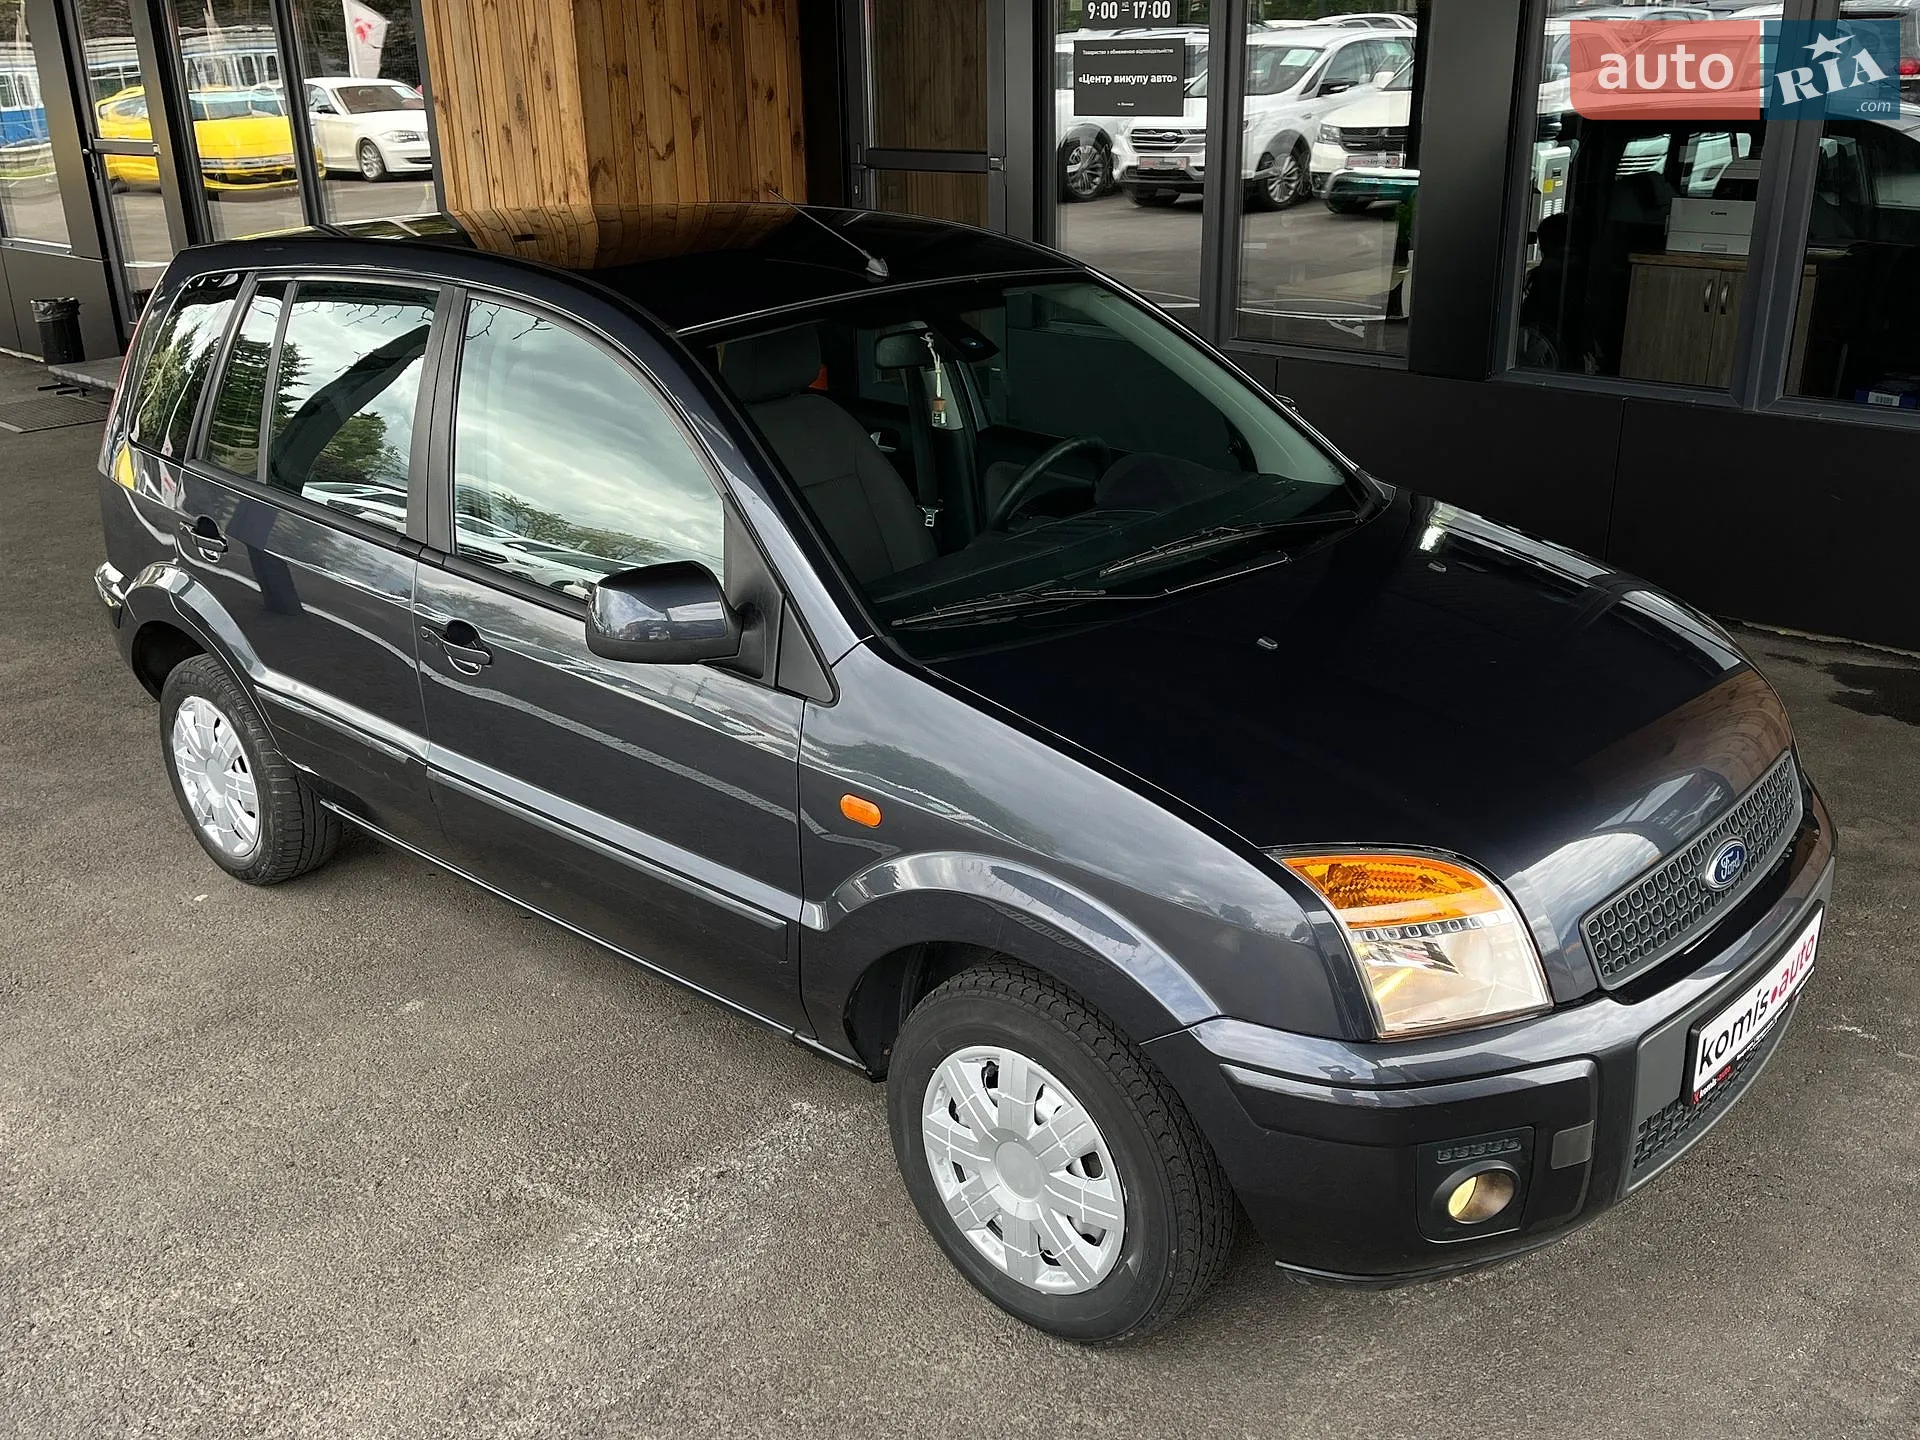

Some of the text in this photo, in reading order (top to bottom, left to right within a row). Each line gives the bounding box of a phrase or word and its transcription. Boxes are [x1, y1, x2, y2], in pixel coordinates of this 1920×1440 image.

[1087, 1, 1118, 20] 9:00
[1133, 0, 1171, 19] 17:00
[1078, 73, 1178, 86] «Центр викупу авто»
[1720, 850, 1740, 880] Ford
